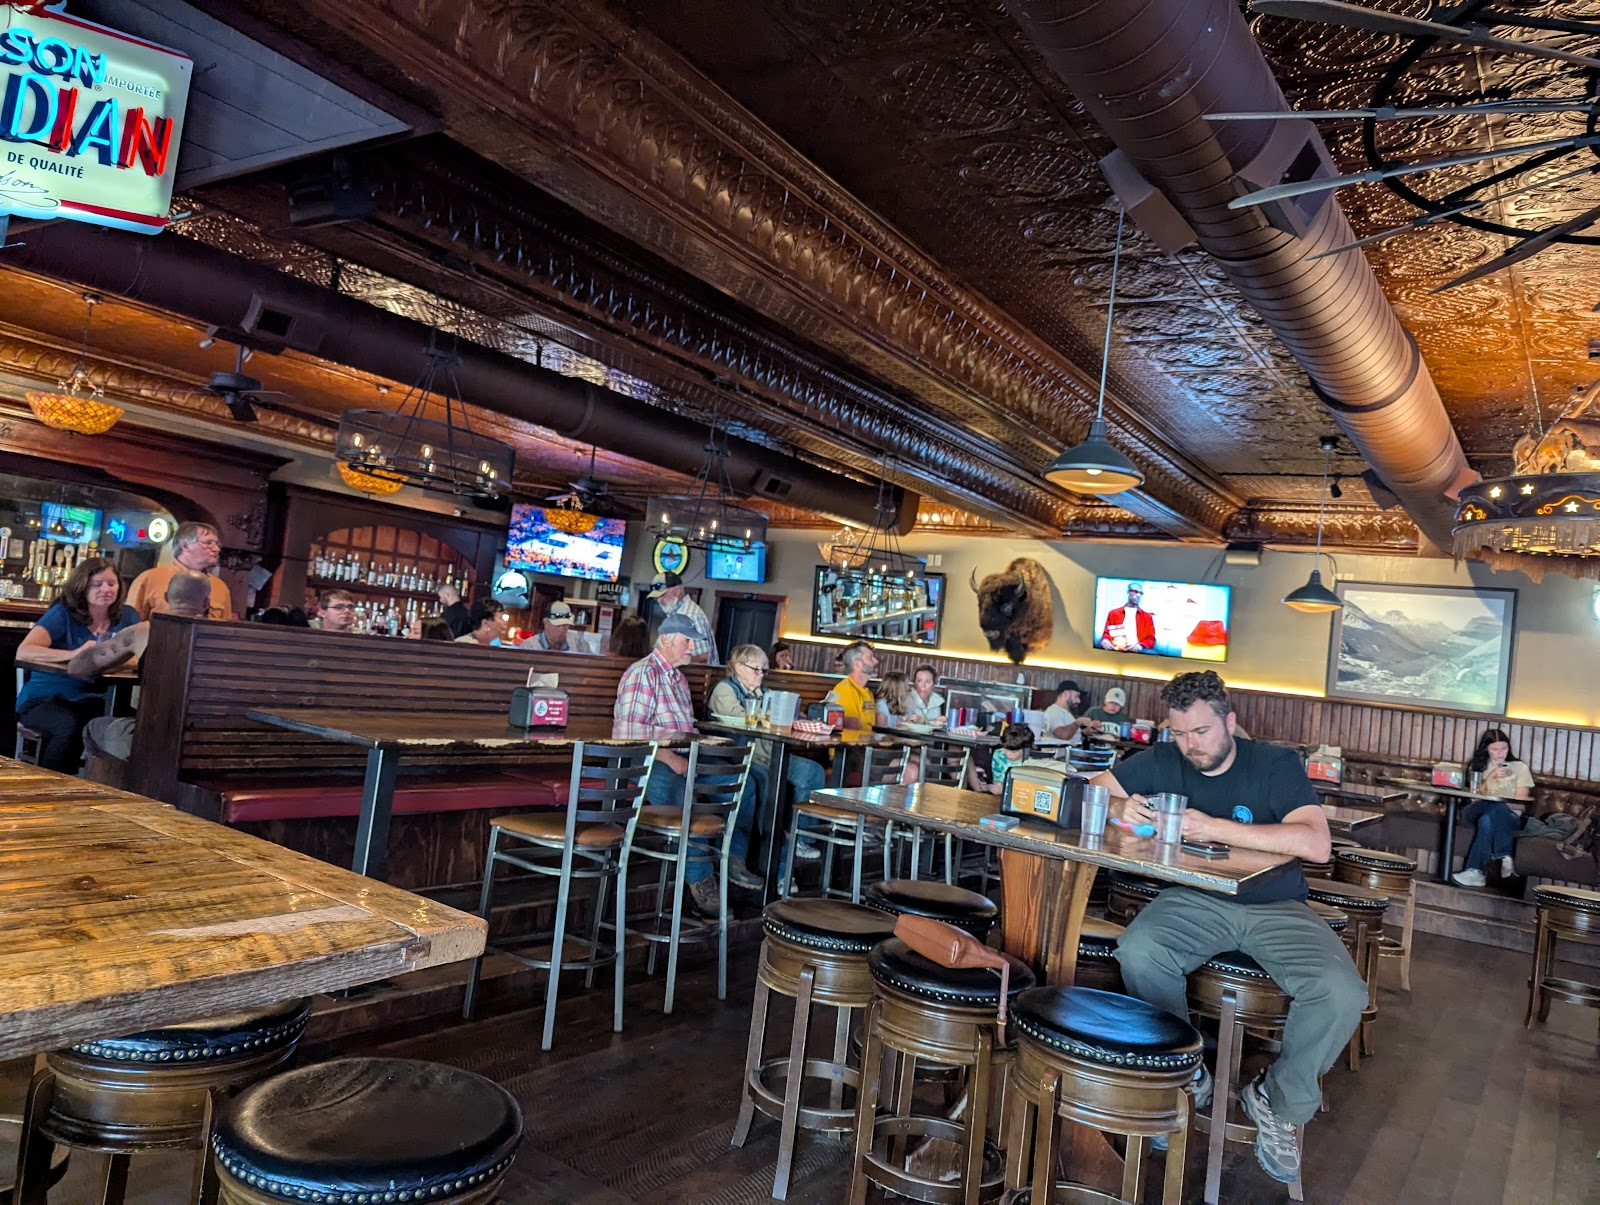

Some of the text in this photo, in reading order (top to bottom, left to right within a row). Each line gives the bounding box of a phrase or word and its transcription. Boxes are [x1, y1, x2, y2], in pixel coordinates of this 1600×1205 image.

[0, 28, 106, 89] SON
[103, 75, 161, 100] IMPORTÉE
[0, 73, 173, 177] DIAN
[7, 151, 84, 178] DE QUALITÉ
[598, 583, 623, 593] BULLEI
